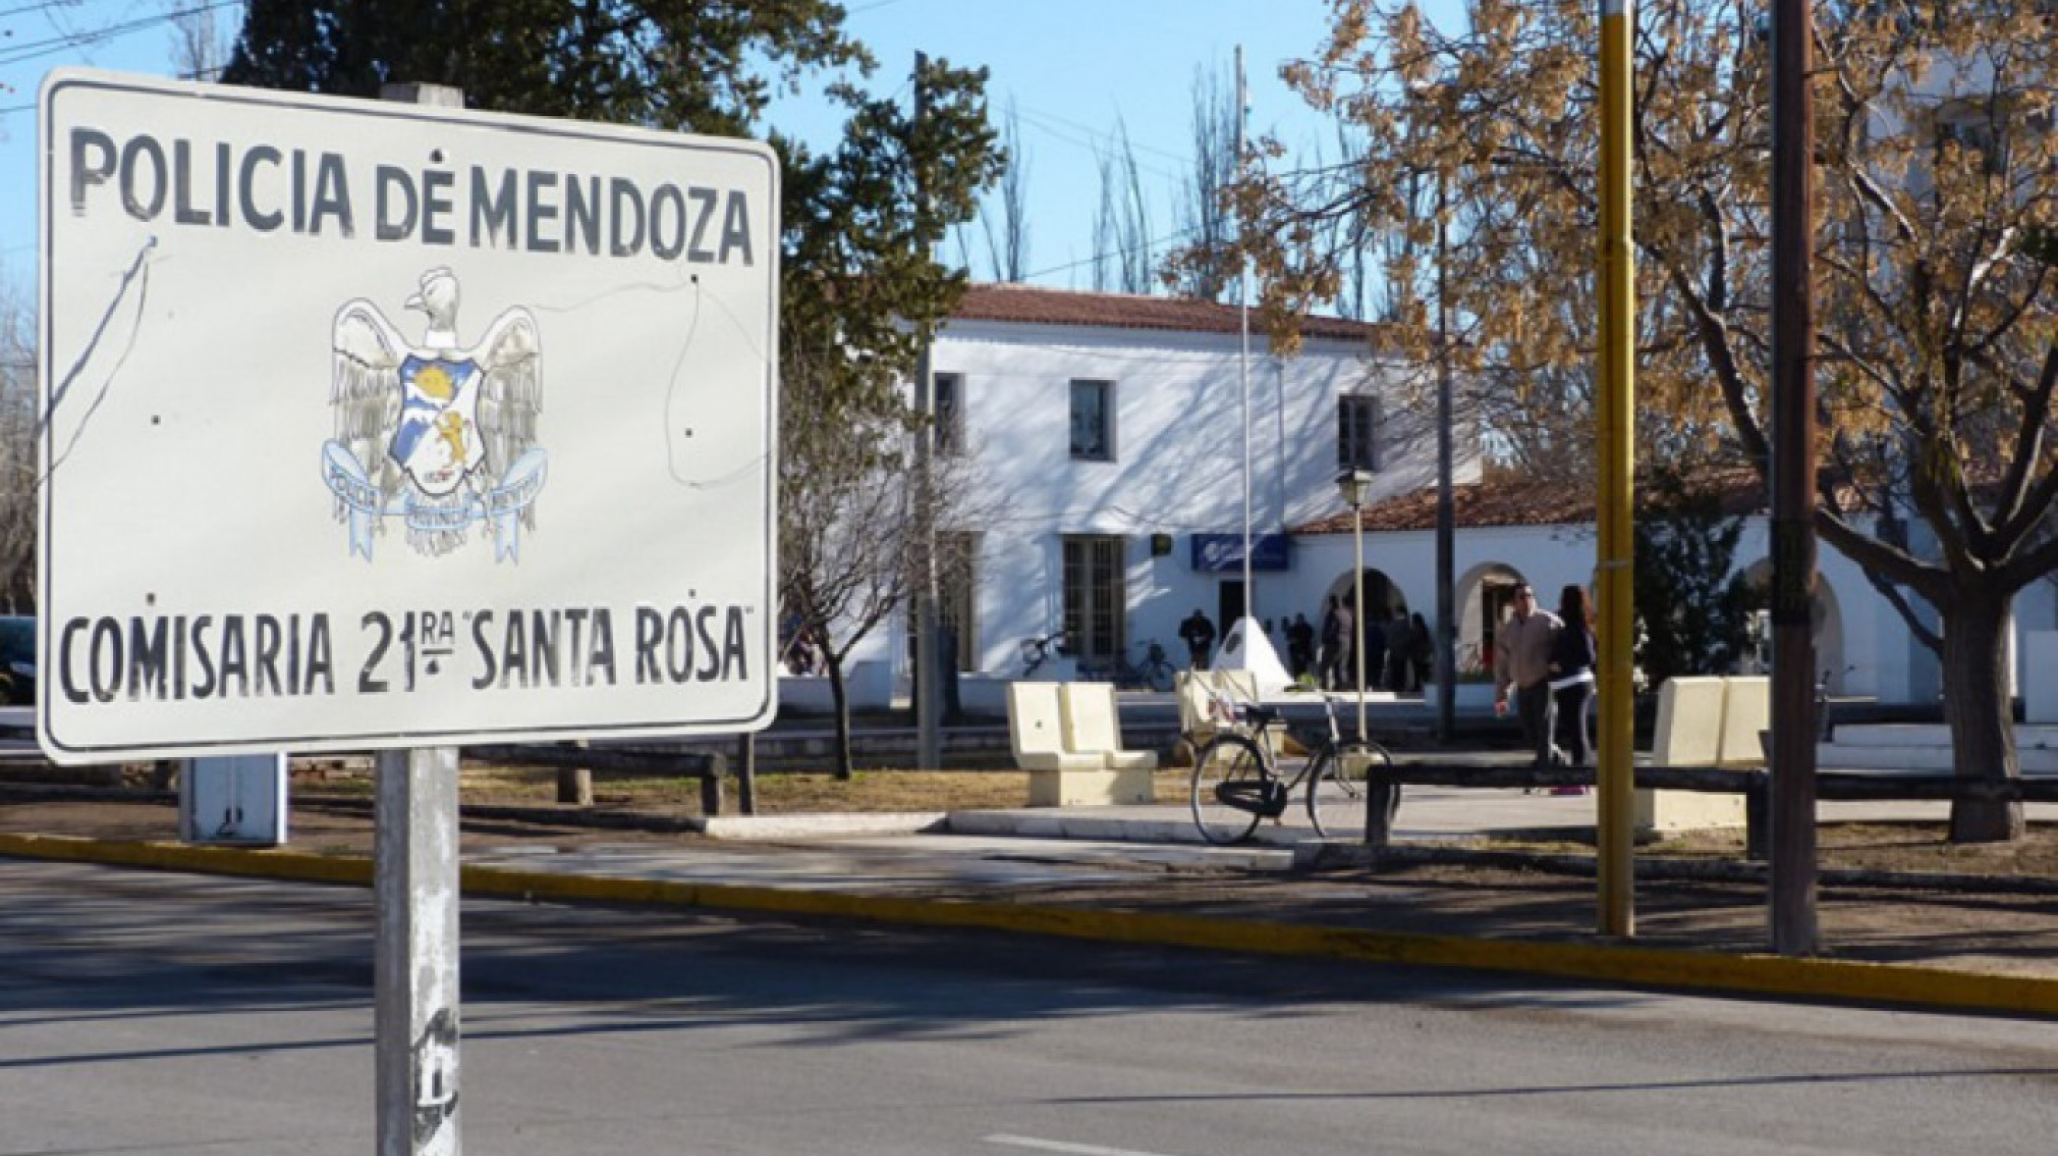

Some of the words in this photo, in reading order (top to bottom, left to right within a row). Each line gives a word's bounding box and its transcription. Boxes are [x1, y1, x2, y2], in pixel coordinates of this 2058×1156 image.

[70, 127, 353, 238] POLICIA
[376, 165, 455, 245] DE
[469, 166, 754, 266] MENDOZA
[60, 613, 335, 703] COMISARIA
